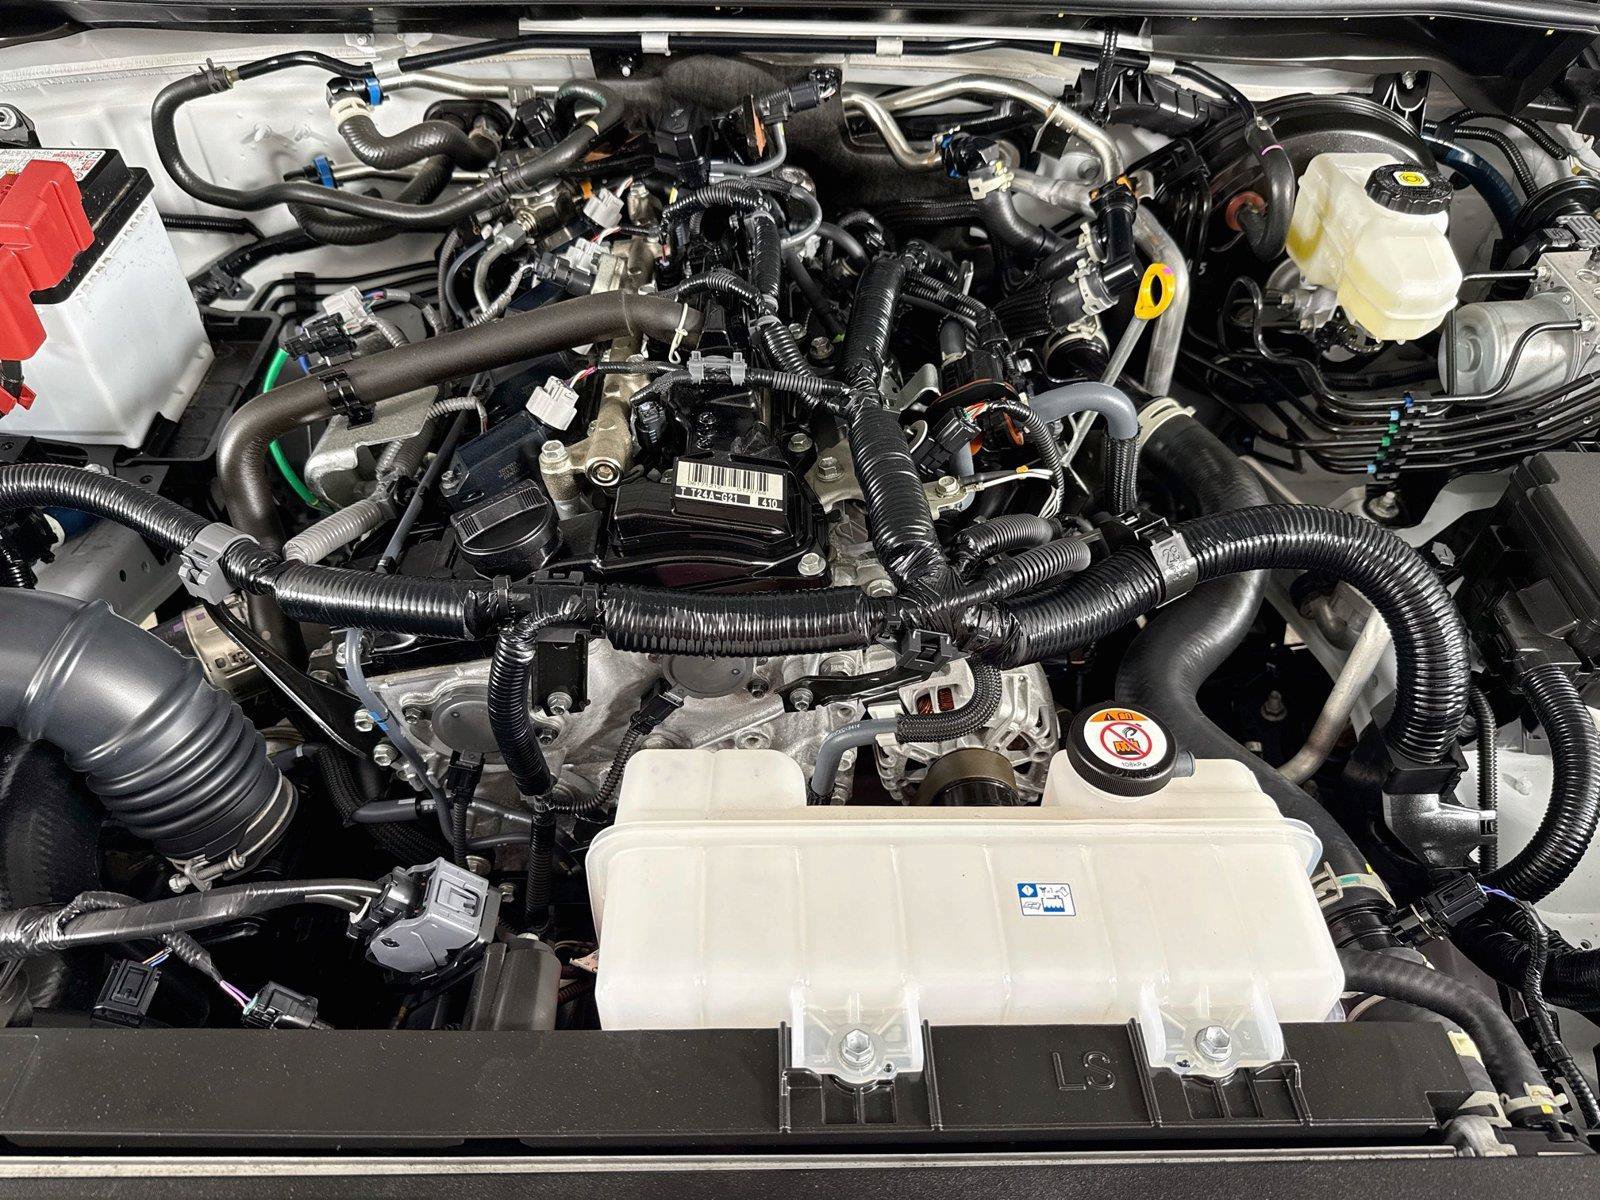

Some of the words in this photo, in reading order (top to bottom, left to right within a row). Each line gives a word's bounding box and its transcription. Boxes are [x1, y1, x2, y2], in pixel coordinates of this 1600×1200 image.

[680, 486, 687, 496] T
[691, 488, 738, 503] T24A-G21
[761, 498, 778, 508] 410
[1052, 1051, 1117, 1091] LS
